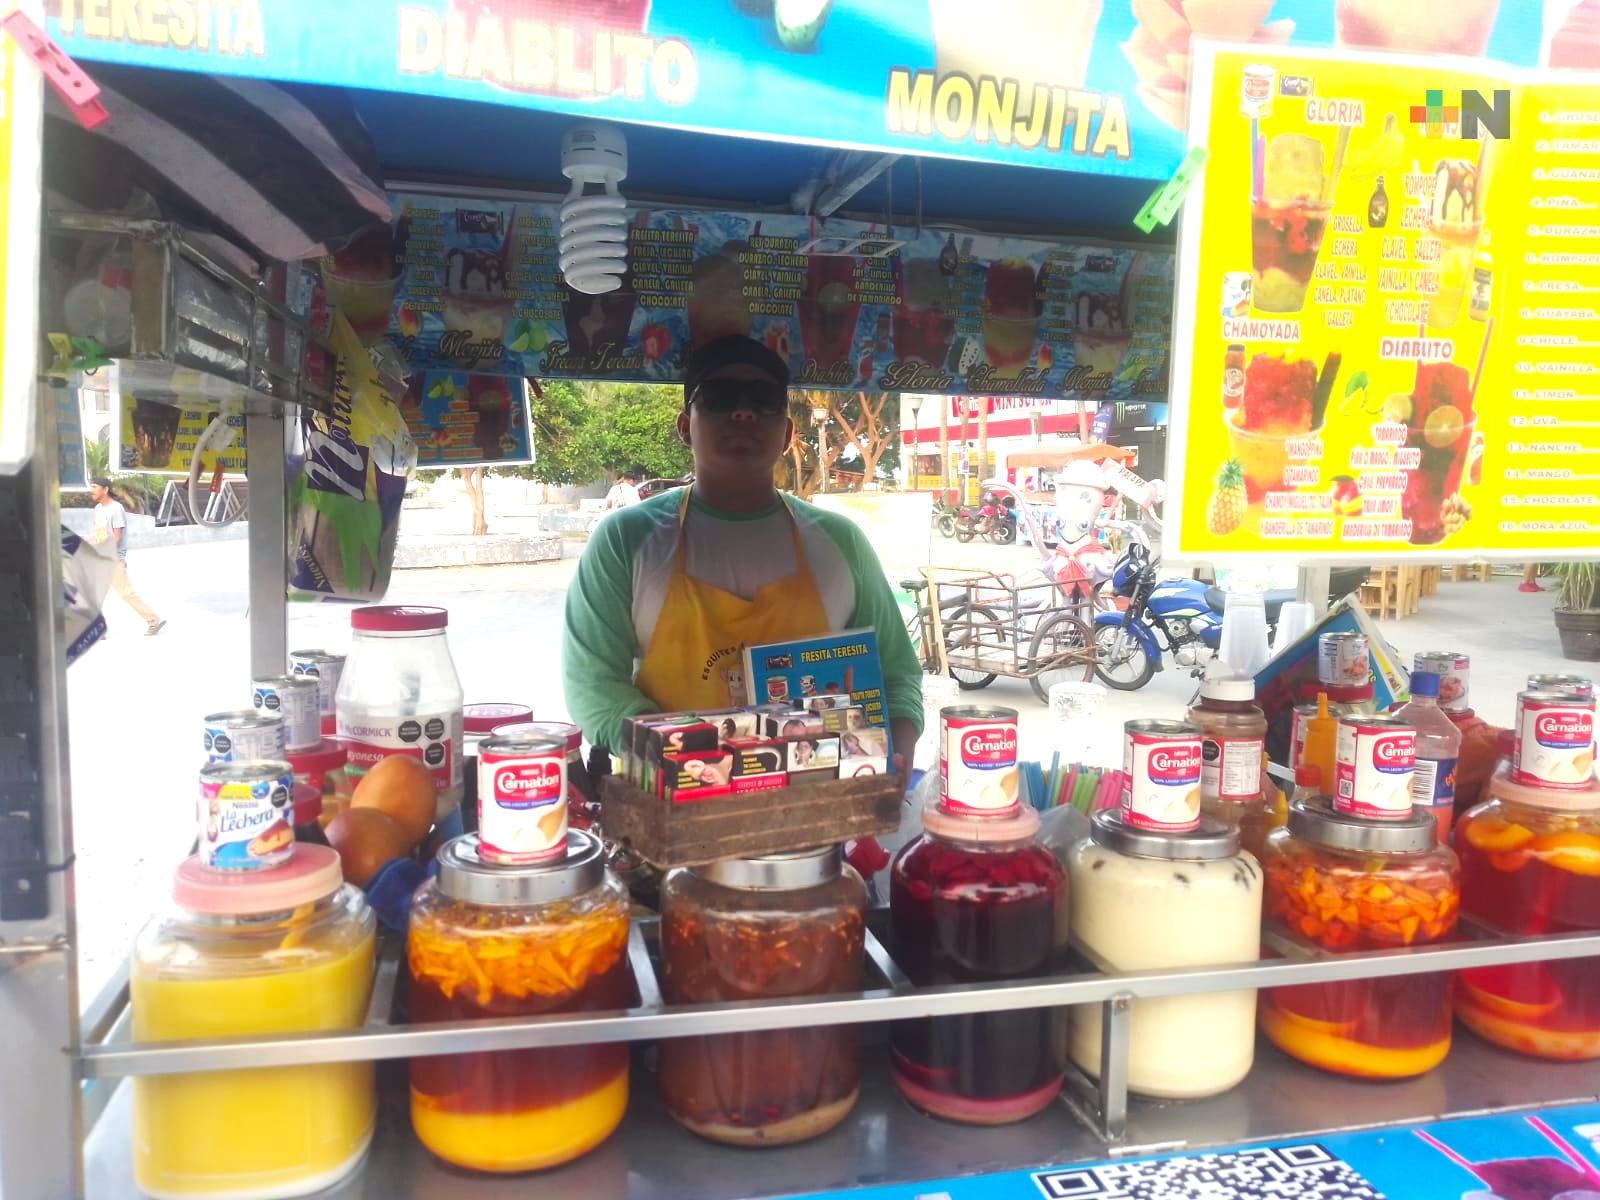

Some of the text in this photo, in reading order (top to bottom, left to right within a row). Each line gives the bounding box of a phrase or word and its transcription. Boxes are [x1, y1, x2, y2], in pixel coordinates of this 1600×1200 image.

[398, 6, 698, 105] DIABLITO
[887, 68, 1131, 159] MONJITA
[1307, 99, 1363, 124] GLORIA
[1223, 321, 1300, 341] CHAMOYADA
[1381, 340, 1453, 359] DIABLITO
[1527, 469, 1572, 479] MANGO
[800, 642, 870, 664] FRESITA TERESITA
[1539, 717, 1592, 735] Carnation
[497, 772, 561, 793] Carnation
[220, 808, 275, 834] Lechera
